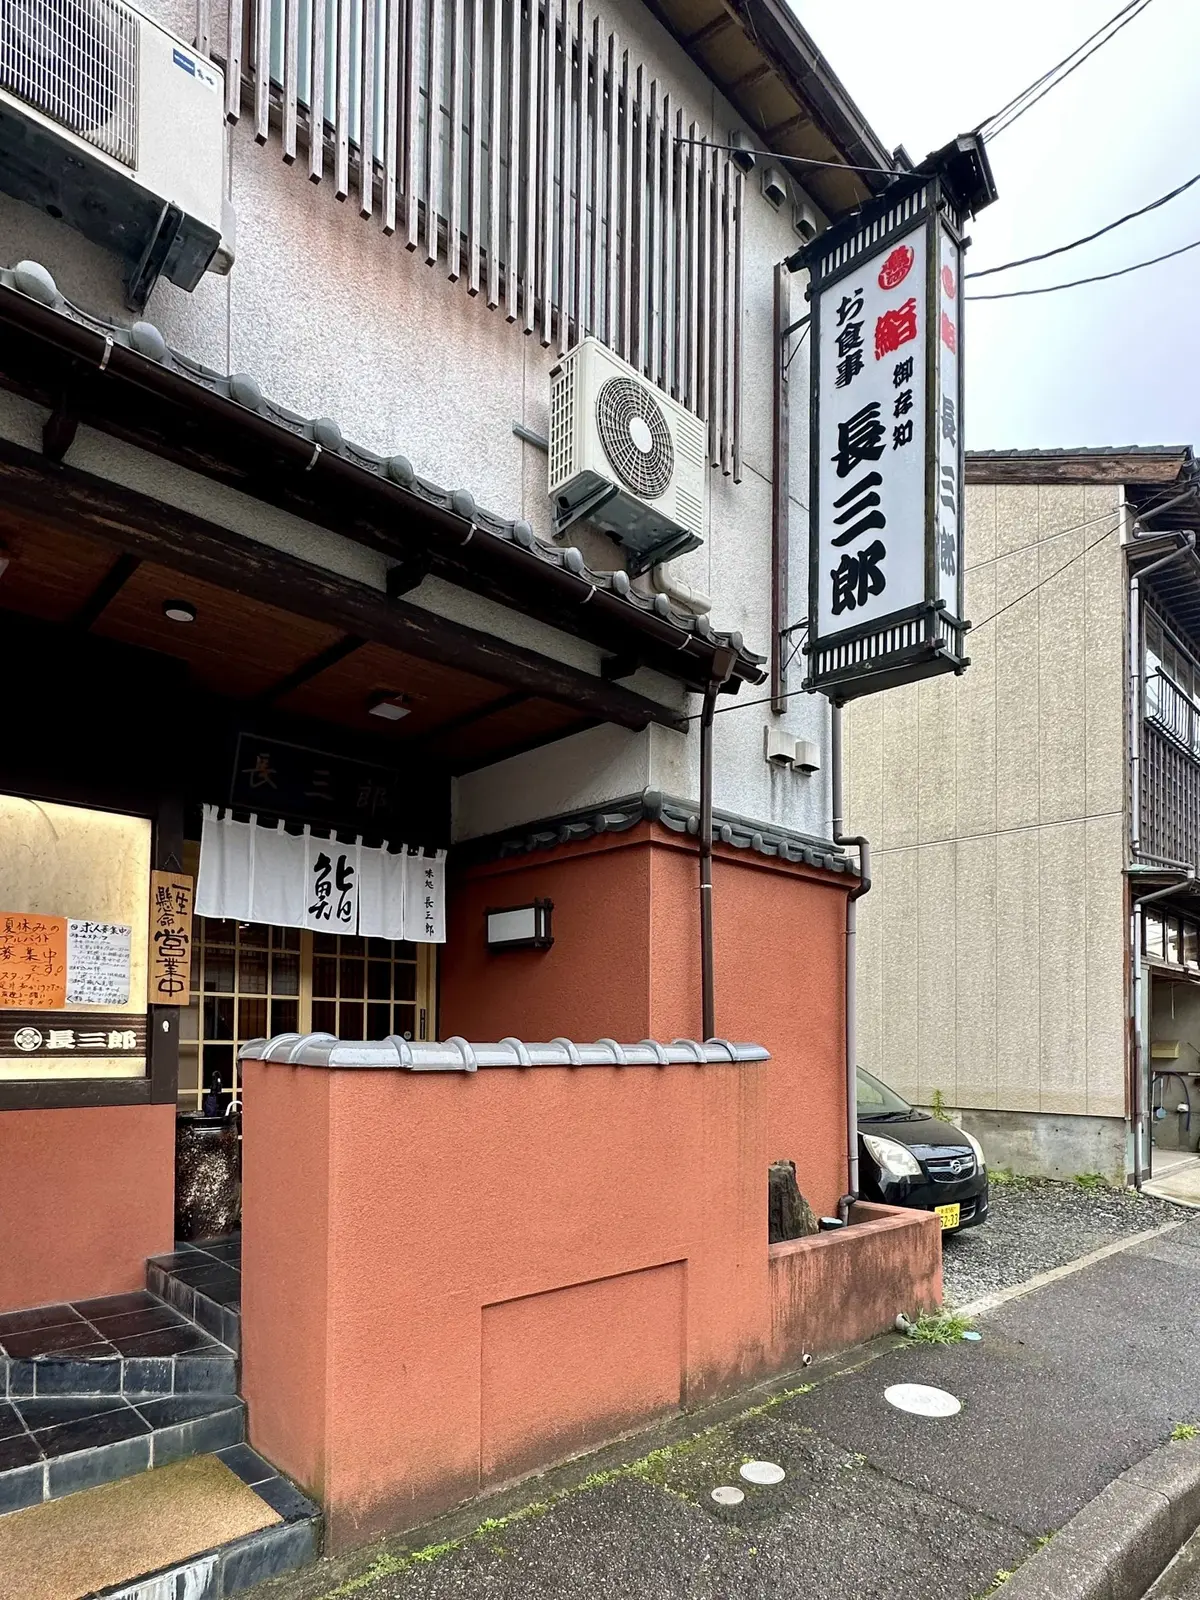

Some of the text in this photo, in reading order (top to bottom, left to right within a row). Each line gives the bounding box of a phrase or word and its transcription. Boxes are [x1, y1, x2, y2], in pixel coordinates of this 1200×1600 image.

[835, 288, 864, 388] お食事
[892, 356, 913, 450] 御存知
[831, 401, 886, 616] 長三郎
[242, 753, 389, 818] 長三郎
[308, 851, 355, 923] 鮨
[424, 896, 434, 937] 長三郎
[0, 933, 49, 943] アルバイト
[0, 945, 57, 965] 募集中
[3, 917, 60, 933] 夏休みの
[154, 927, 188, 997] 営業中
[45, 1029, 137, 1050] 長三郎
